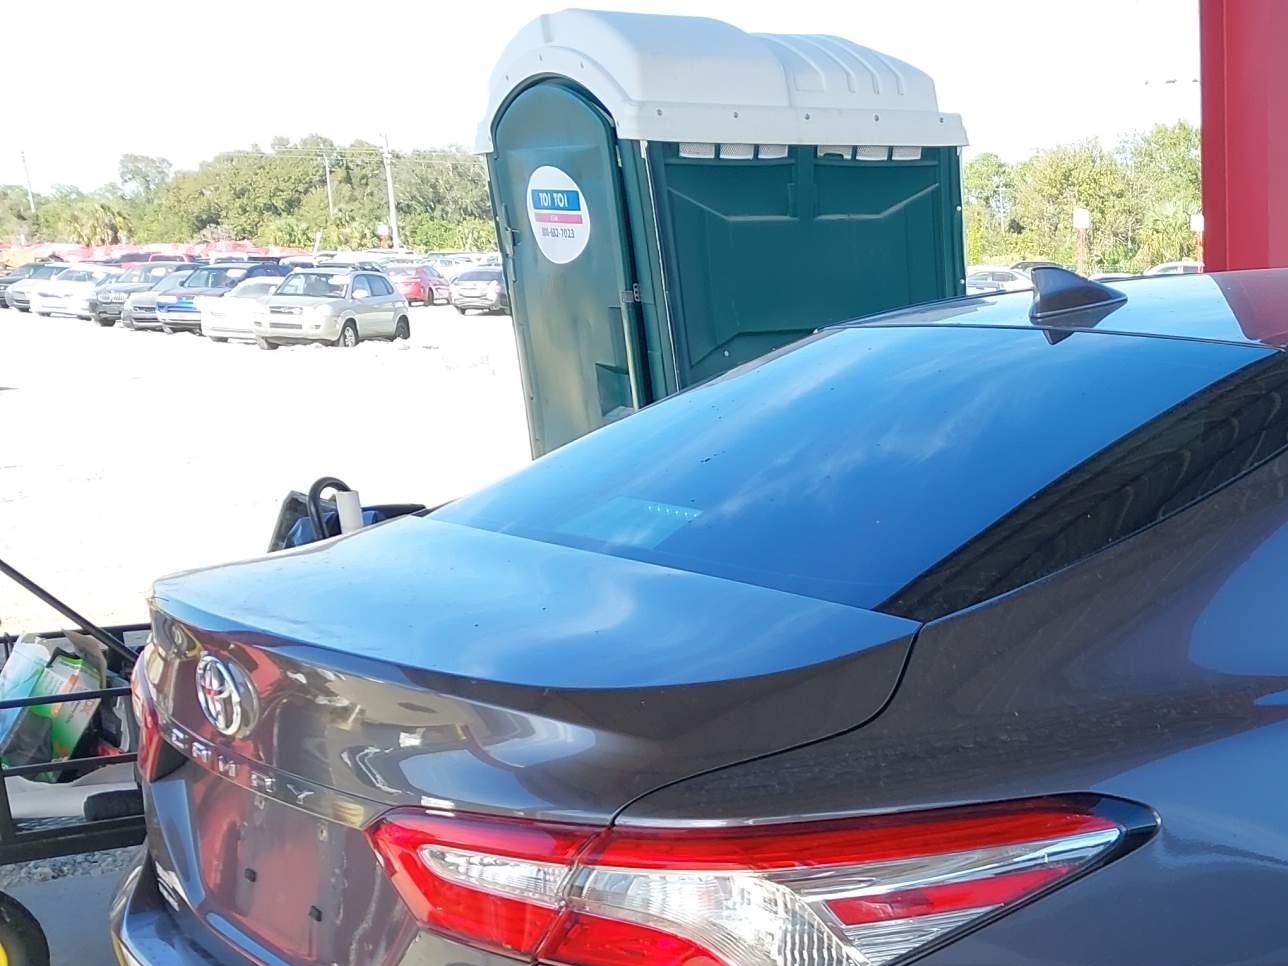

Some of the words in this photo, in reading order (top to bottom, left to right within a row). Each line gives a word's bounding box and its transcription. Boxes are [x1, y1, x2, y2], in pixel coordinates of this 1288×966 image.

[538, 192, 552, 207] TOI
[553, 193, 568, 208] TOI
[170, 727, 315, 805] CAMRY
